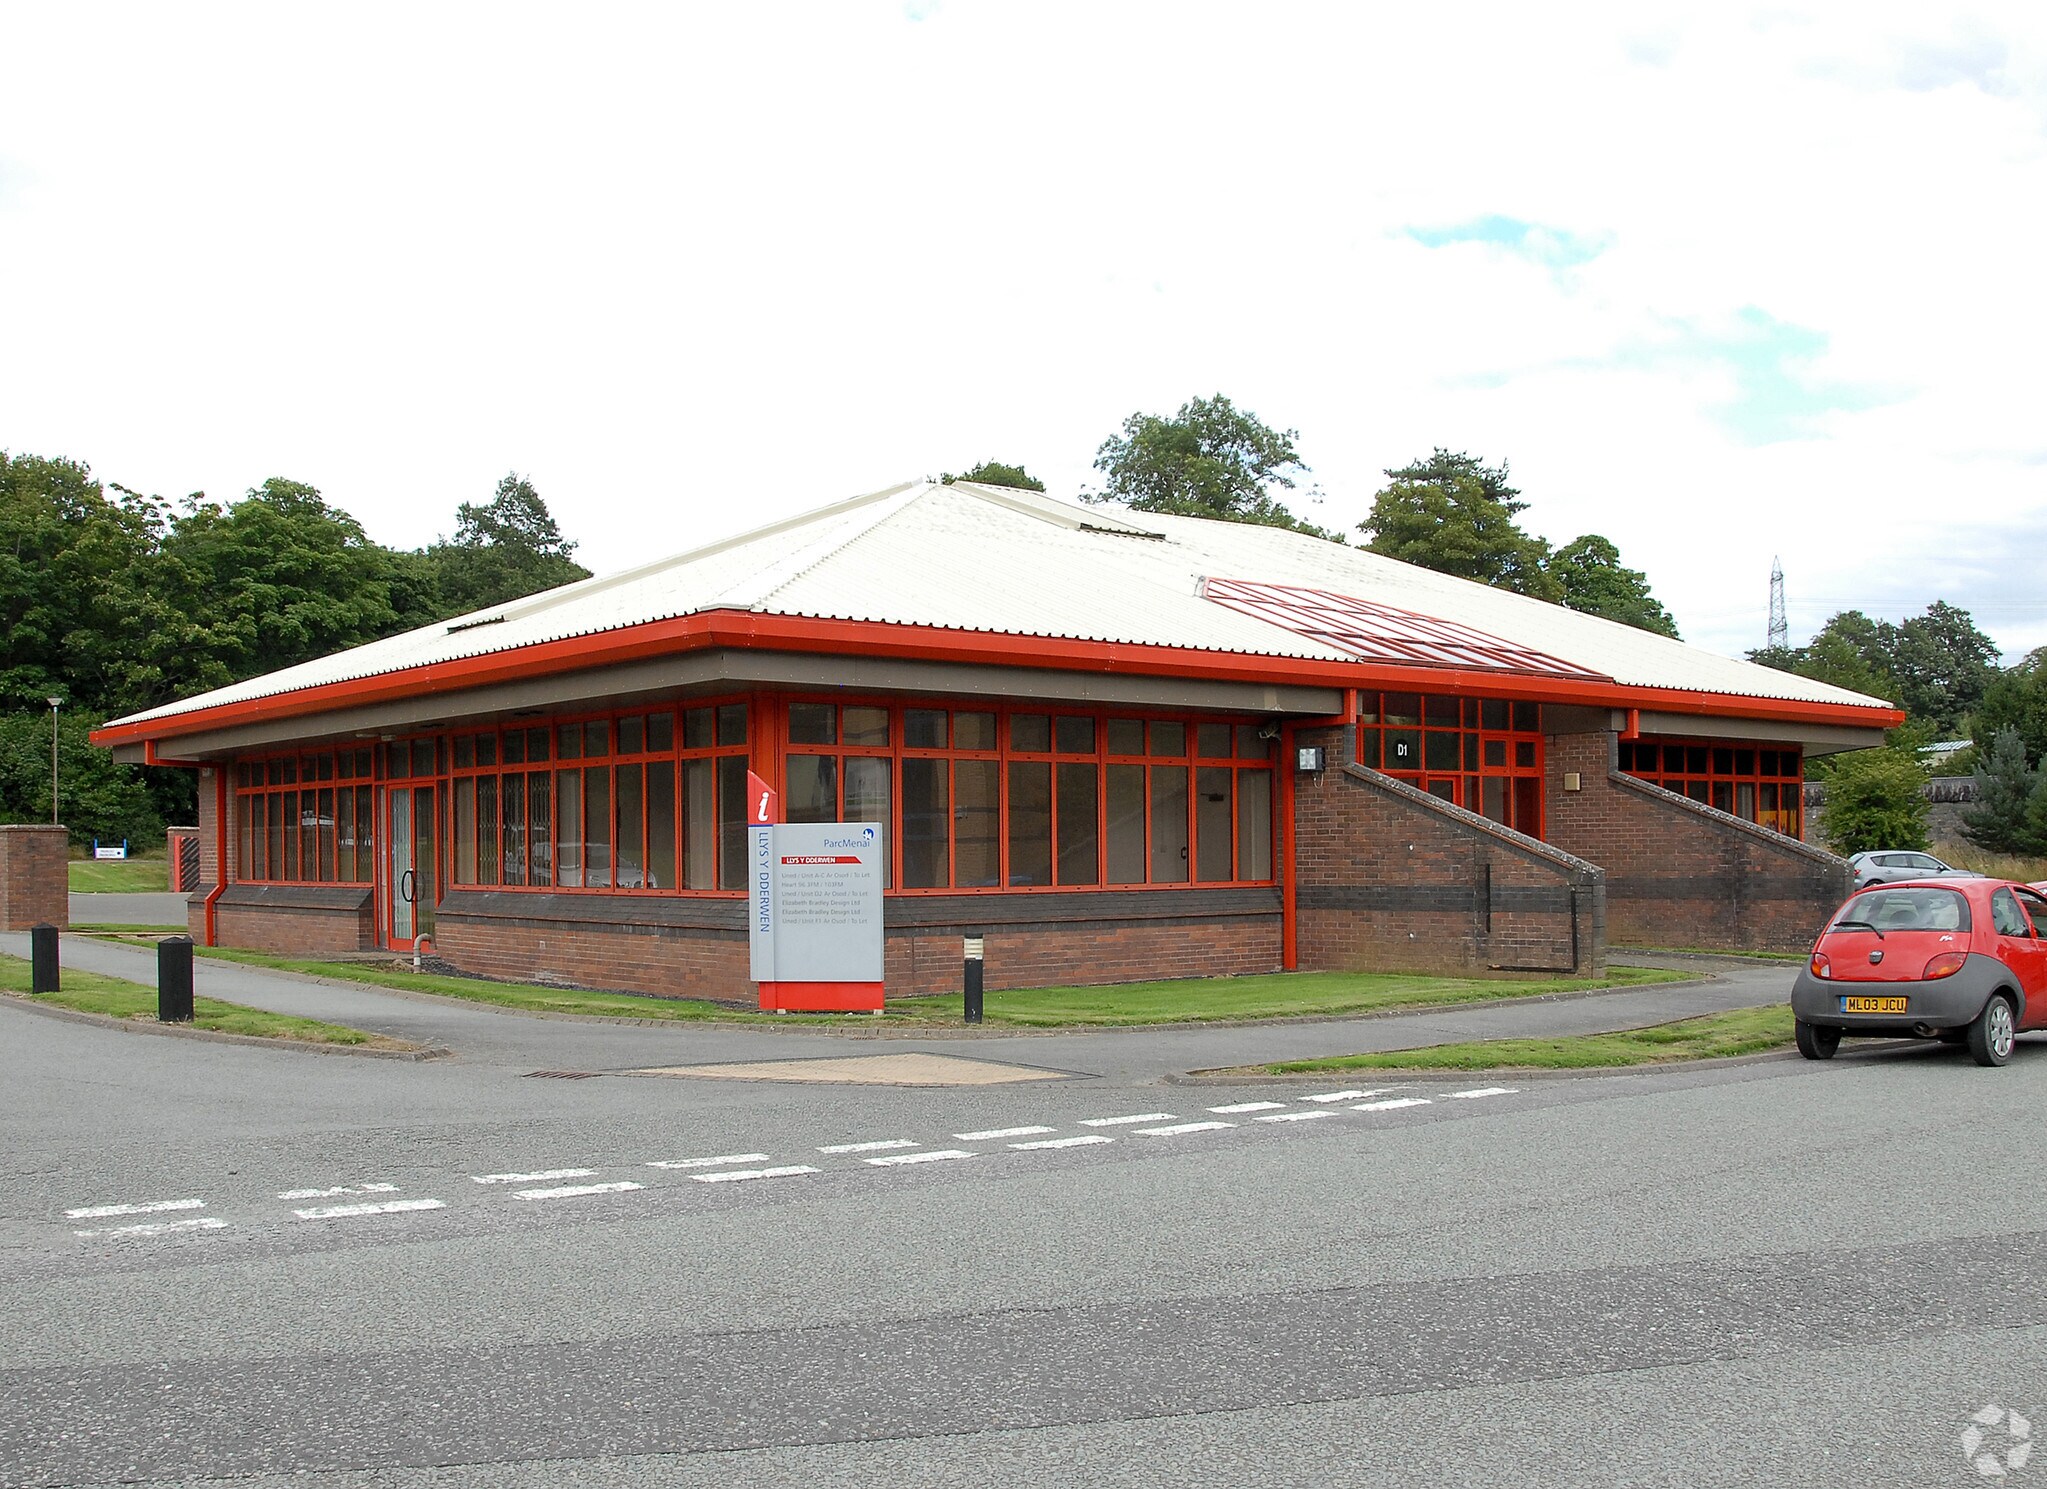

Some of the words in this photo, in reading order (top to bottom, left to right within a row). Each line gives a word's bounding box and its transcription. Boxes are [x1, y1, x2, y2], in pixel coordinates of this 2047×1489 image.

[1397, 743, 1408, 756] D1
[758, 832, 769, 857] LLYS
[823, 838, 870, 848] ParcMenai
[759, 861, 769, 869] Y
[759, 872, 770, 933] DDERWEN
[1848, 998, 1878, 1011] ML03
[1881, 998, 1904, 1011] JCU
